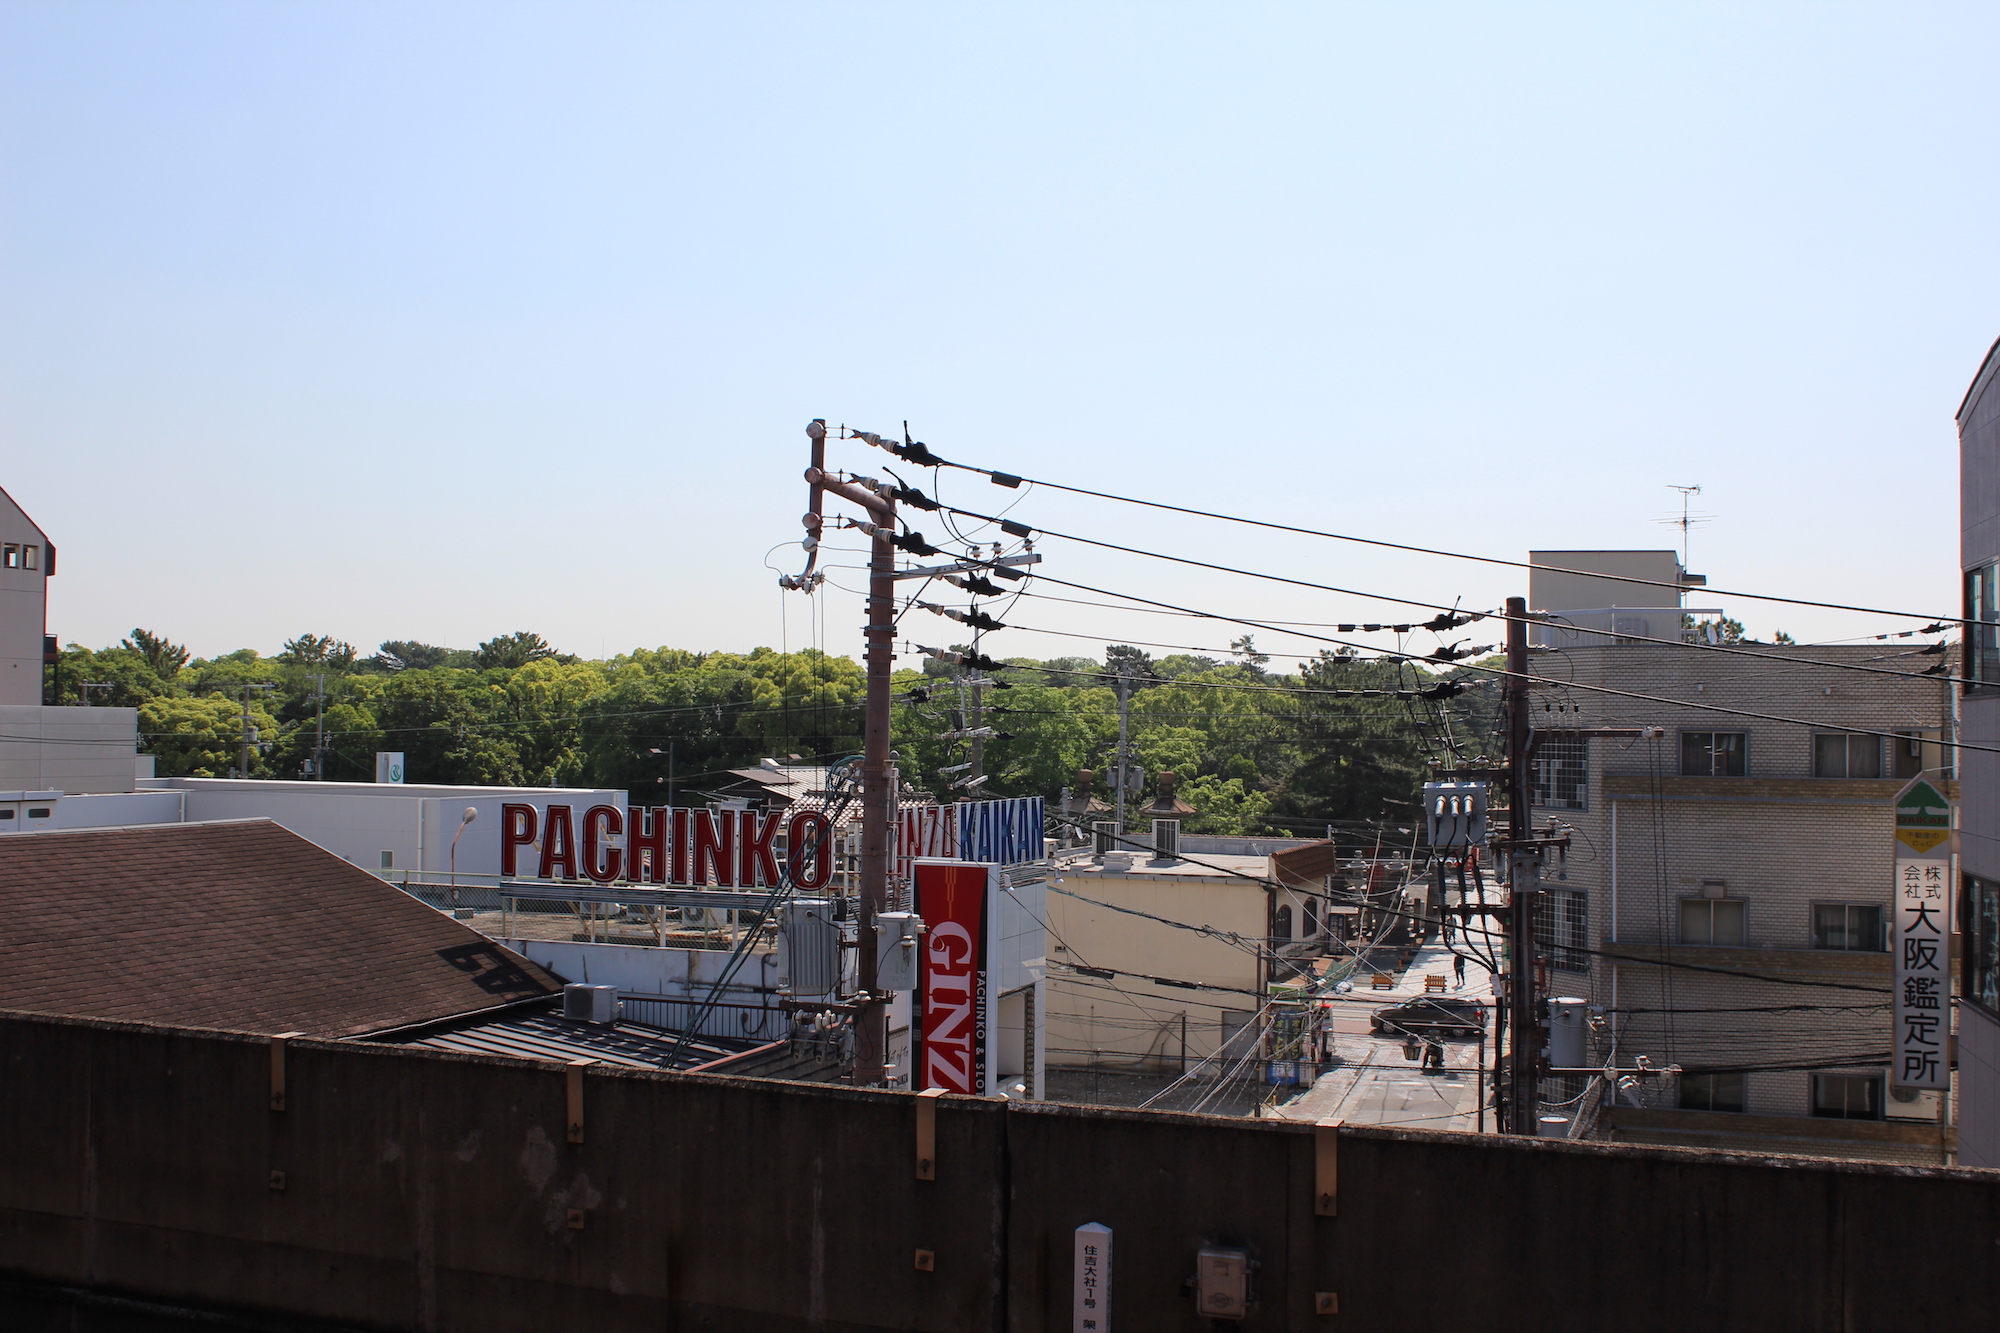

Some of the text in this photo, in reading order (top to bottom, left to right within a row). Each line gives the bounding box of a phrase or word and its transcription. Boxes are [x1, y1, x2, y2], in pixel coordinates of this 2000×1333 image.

[501, 803, 834, 892] PACHINKO
[960, 797, 1044, 866] KAIKAN
[1897, 816, 1947, 824] DAIKAN
[1906, 831, 1940, 840] 不動産の
[976, 970, 986, 1040] PACHINKO
[1902, 901, 1941, 1083] 大阪鑑定所
[975, 1046, 985, 1055] &
[1083, 1245, 1098, 1330] 住吉大社1号 架
